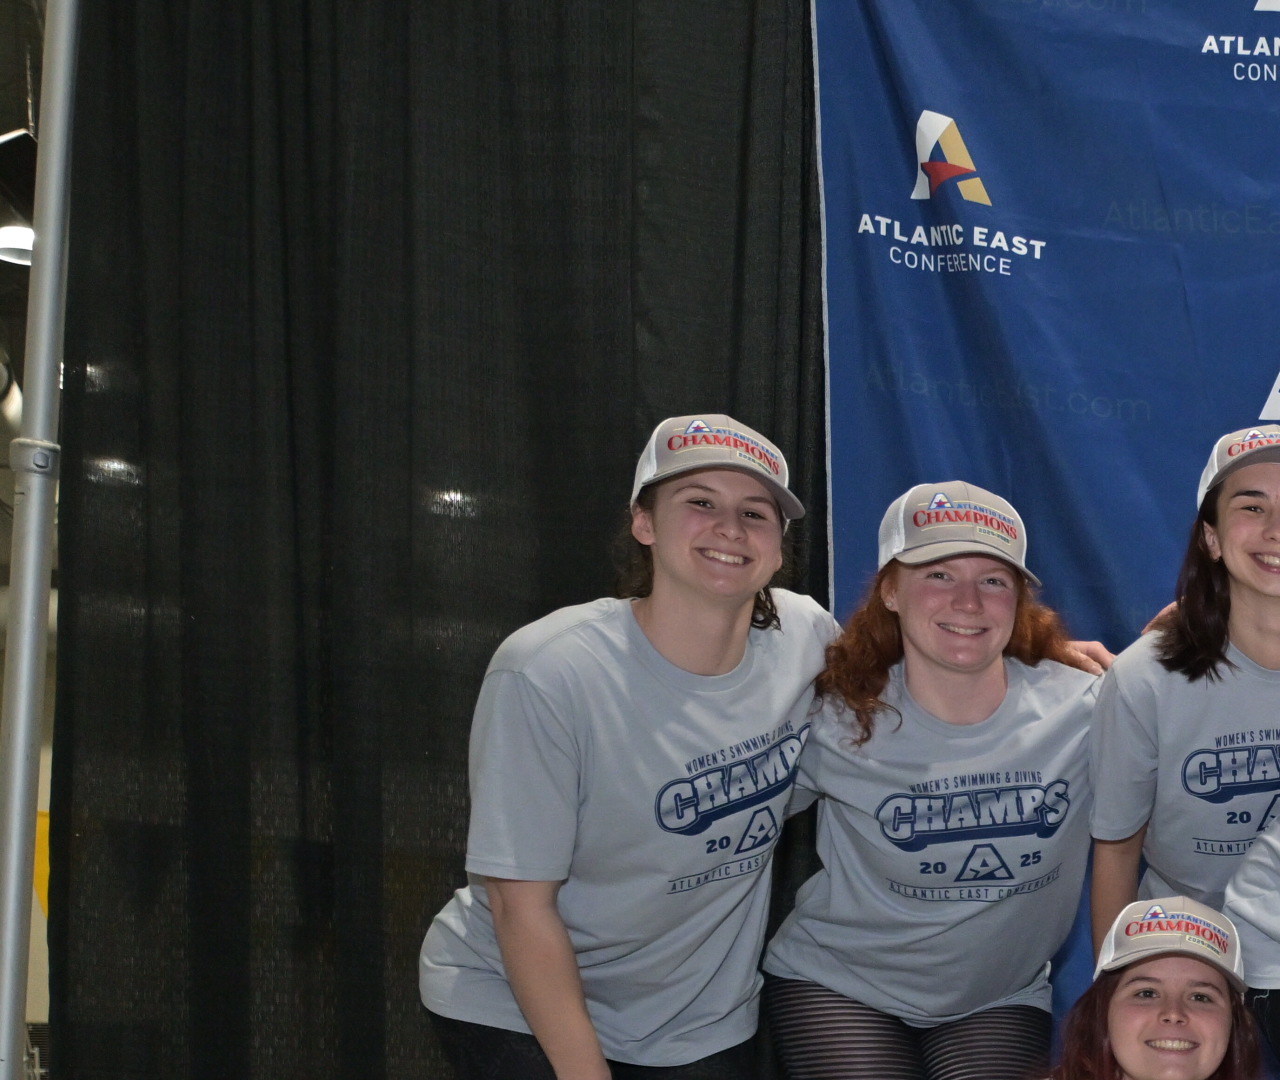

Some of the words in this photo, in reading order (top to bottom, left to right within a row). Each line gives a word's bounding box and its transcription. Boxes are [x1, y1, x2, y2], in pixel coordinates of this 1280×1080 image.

[858, 214, 963, 246] ATLANTIC
[969, 226, 1046, 264] EAST
[890, 242, 1011, 275] CONFERENCE
[668, 435, 780, 475] CHAMPIONS
[913, 510, 1017, 540] CHAMPIONS
[909, 779, 949, 795] WOMEN'S
[954, 773, 1000, 789] SWIMMING
[1004, 772, 1011, 783] &
[1014, 771, 1042, 784] DIVING
[874, 778, 1070, 846] CHAMPS
[1226, 811, 1251, 824] 20
[706, 836, 731, 854] 20
[920, 861, 947, 874] 20
[1019, 851, 1042, 867] 25
[959, 887, 991, 900] EAST
[1125, 920, 1228, 954] CHAMPIONS
